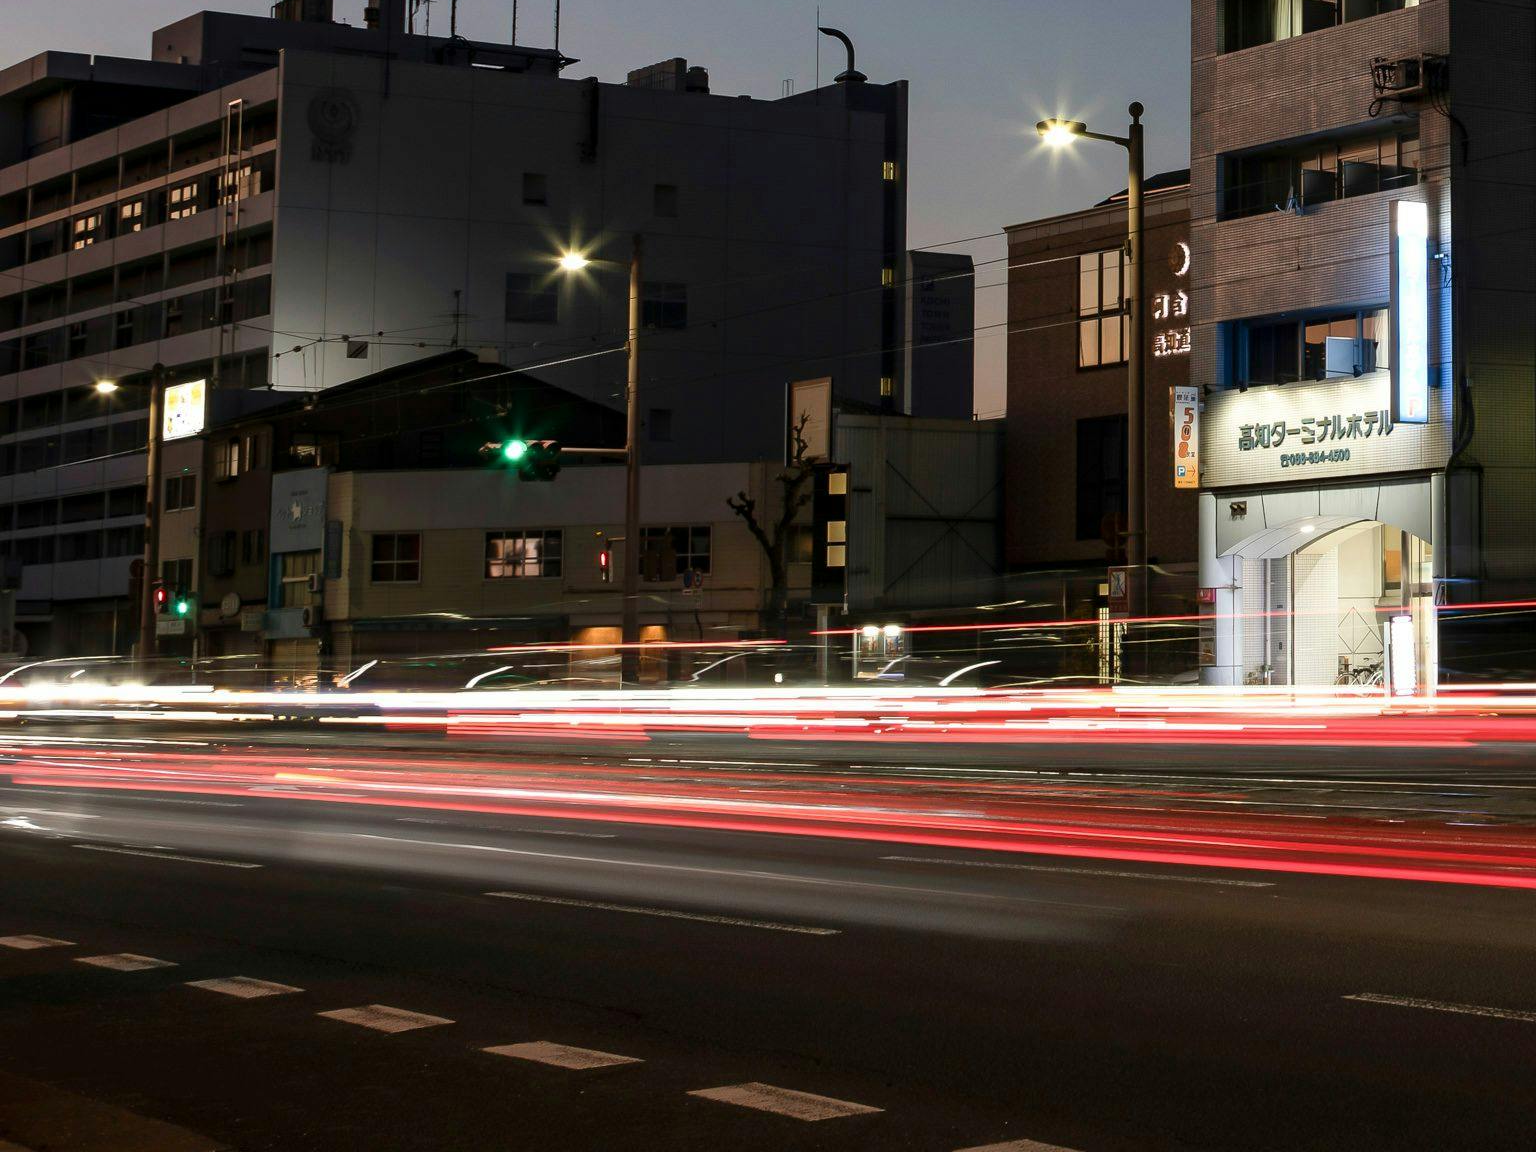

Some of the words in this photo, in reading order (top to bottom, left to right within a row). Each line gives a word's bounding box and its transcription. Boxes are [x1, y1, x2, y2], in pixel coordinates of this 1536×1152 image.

[1238, 409, 1394, 451] 高知ターミナルホテル
